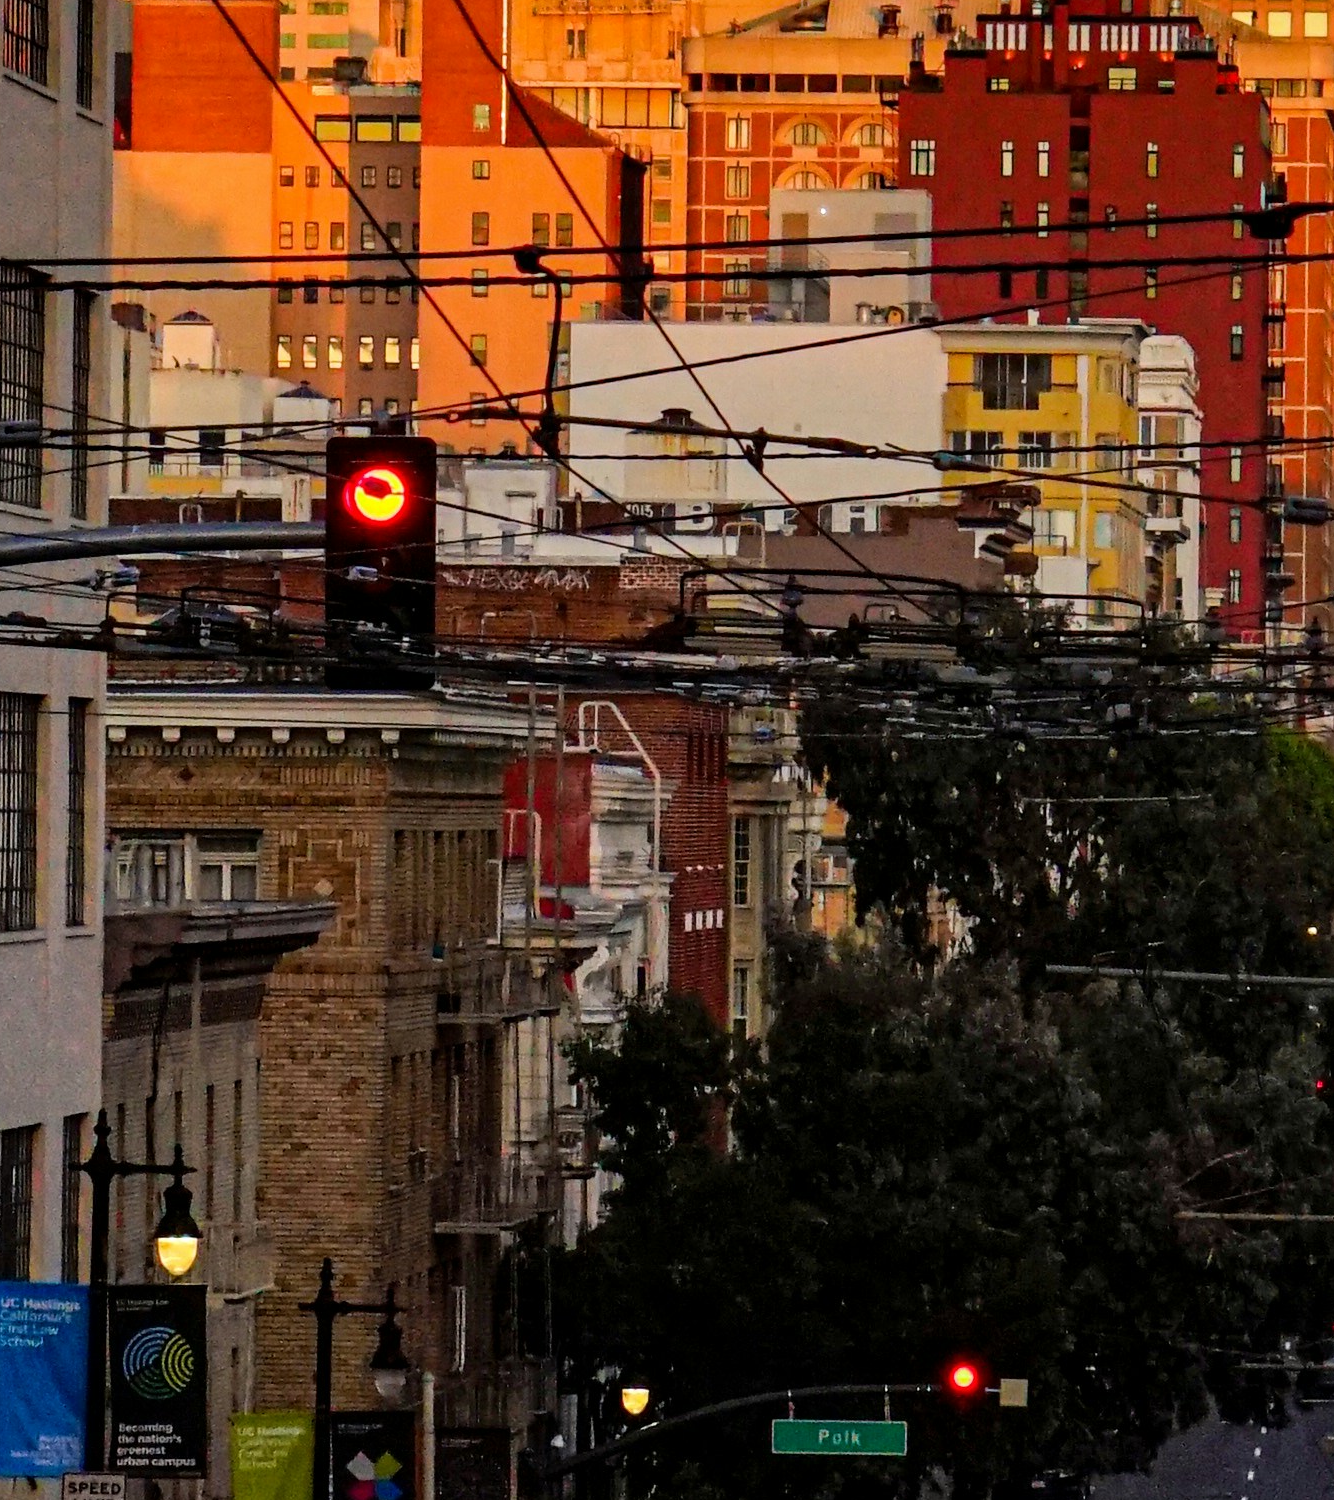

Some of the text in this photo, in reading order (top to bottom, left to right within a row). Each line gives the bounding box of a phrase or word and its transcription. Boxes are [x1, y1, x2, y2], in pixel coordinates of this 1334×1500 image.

[118, 1422, 174, 1434] Becoming
[118, 1435, 136, 1444] the
[818, 1429, 861, 1446] Polk
[117, 1456, 197, 1468] urban campus
[68, 1482, 121, 1496] SPEED
